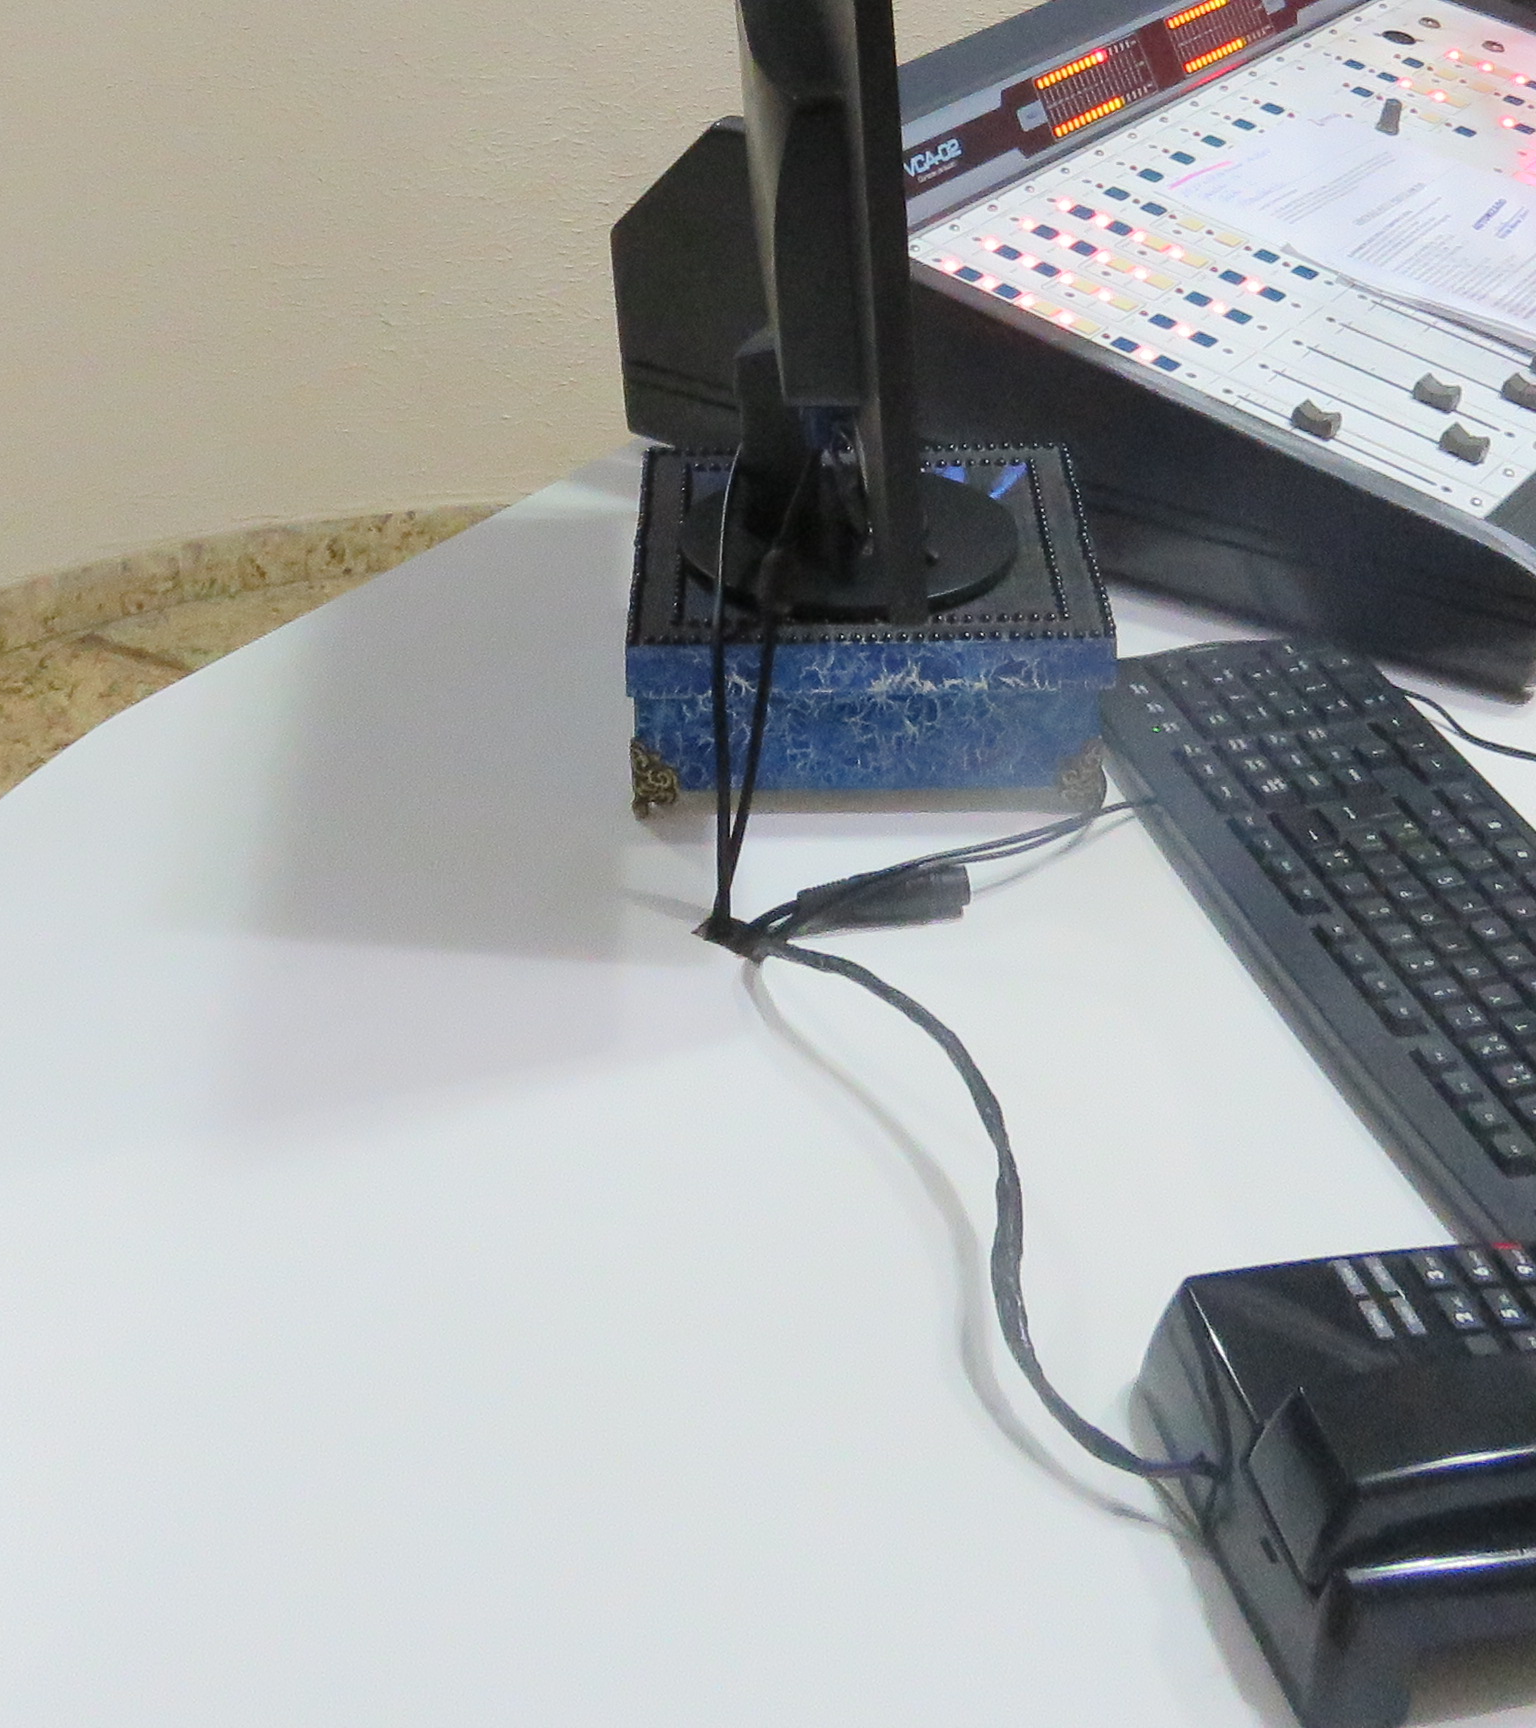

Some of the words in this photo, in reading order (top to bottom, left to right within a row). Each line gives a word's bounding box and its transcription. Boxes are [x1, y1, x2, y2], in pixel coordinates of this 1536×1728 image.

[1426, 1270, 1445, 1281] 3
[1454, 1312, 1475, 1323] 2
[1500, 1308, 1520, 1319] 5
